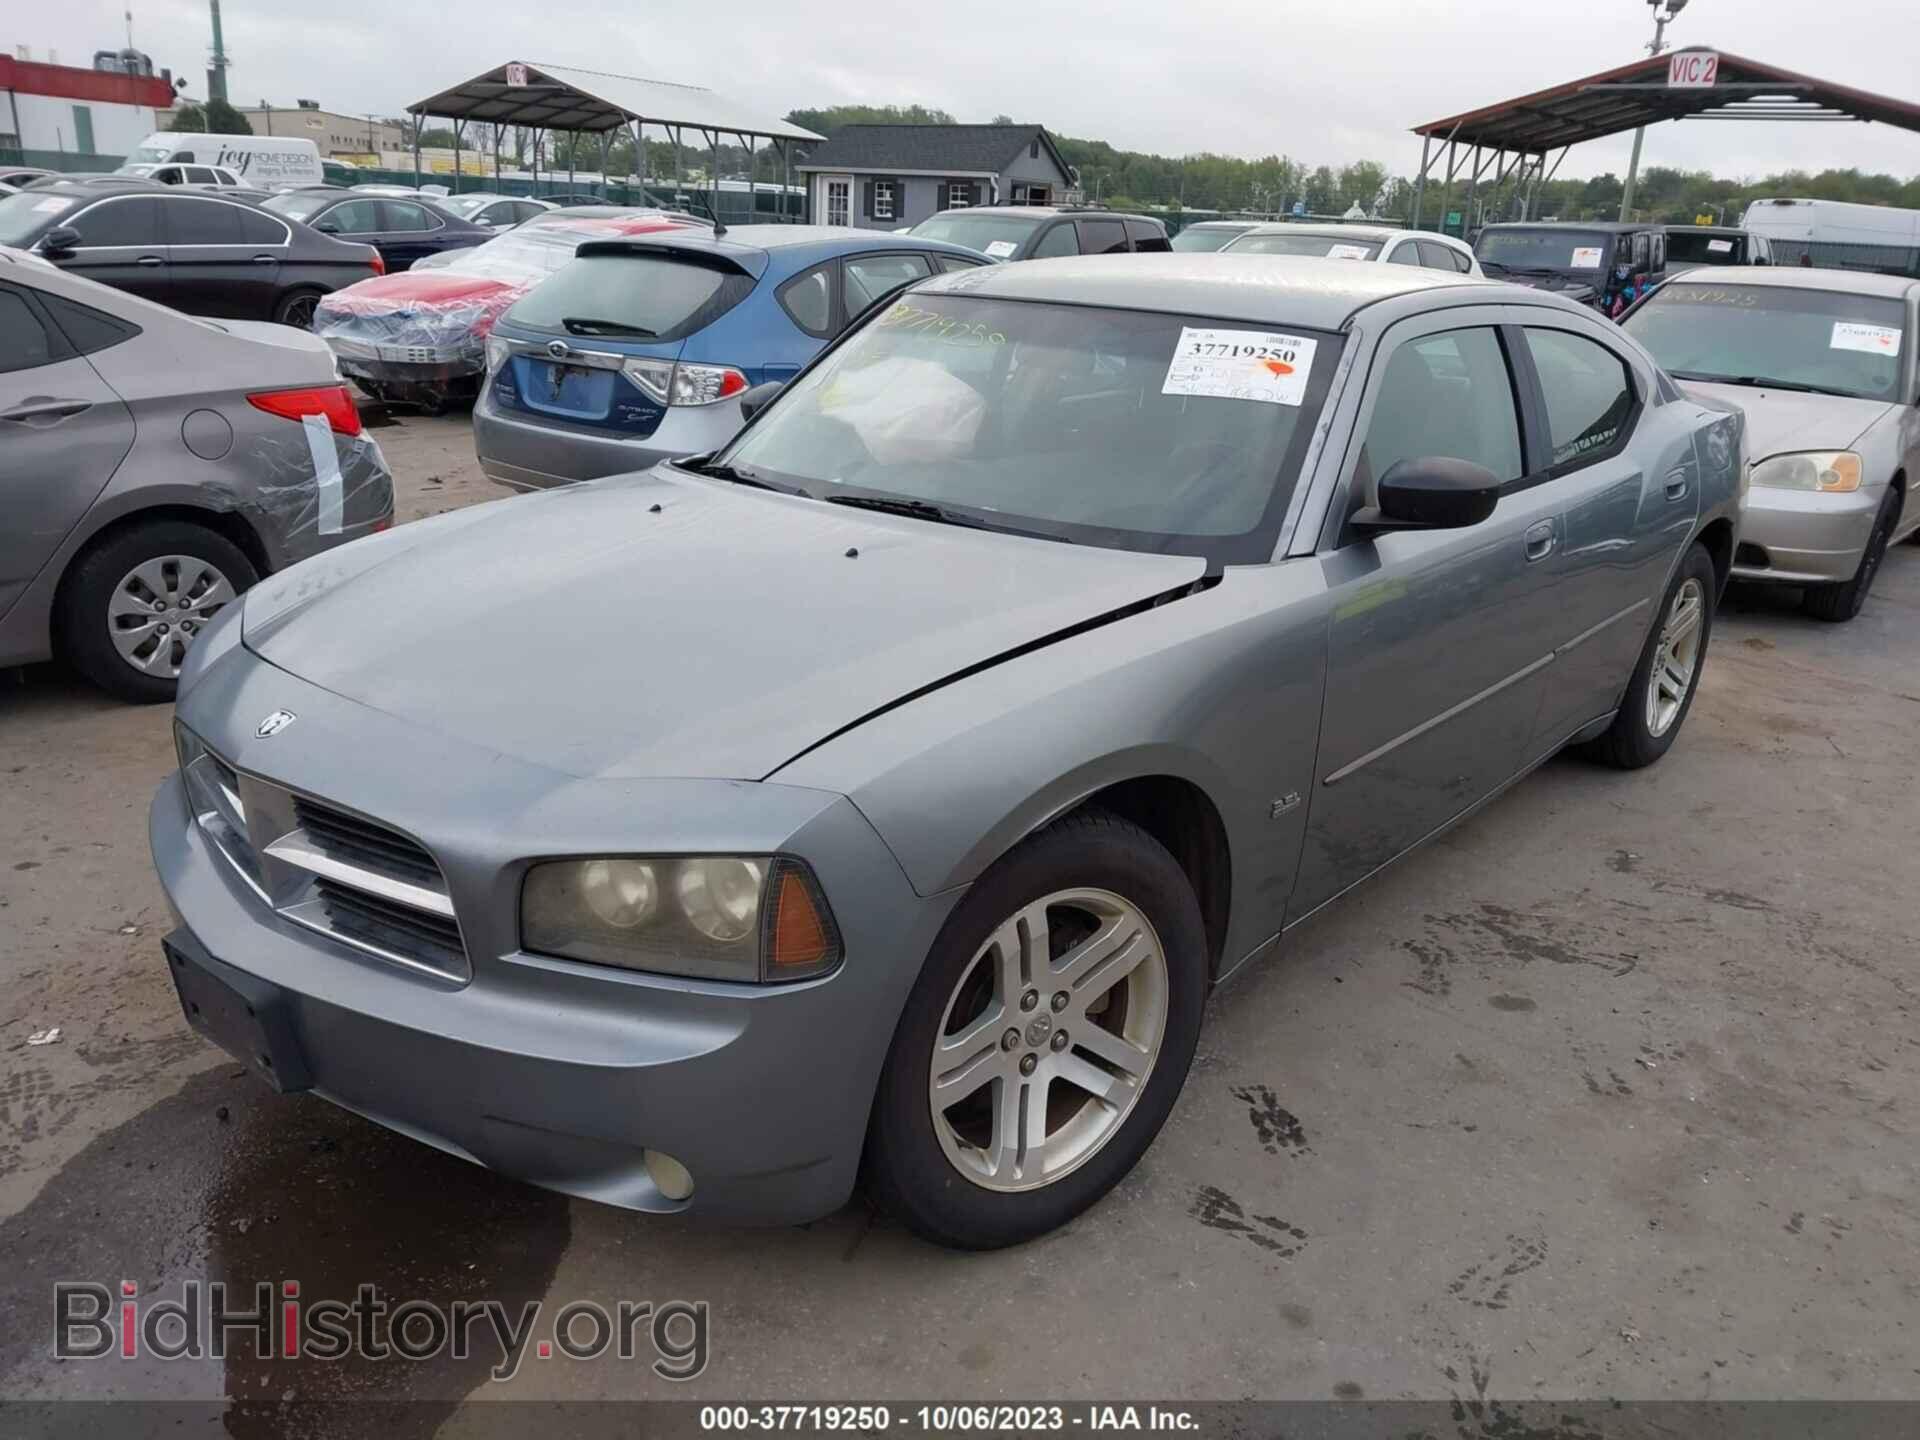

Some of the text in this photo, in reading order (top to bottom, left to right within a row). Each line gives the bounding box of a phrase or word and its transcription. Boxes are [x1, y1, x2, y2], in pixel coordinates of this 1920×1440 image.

[1673, 57, 1716, 82] VIC 2
[216, 144, 252, 177] joy
[1187, 342, 1297, 363] 37719250
